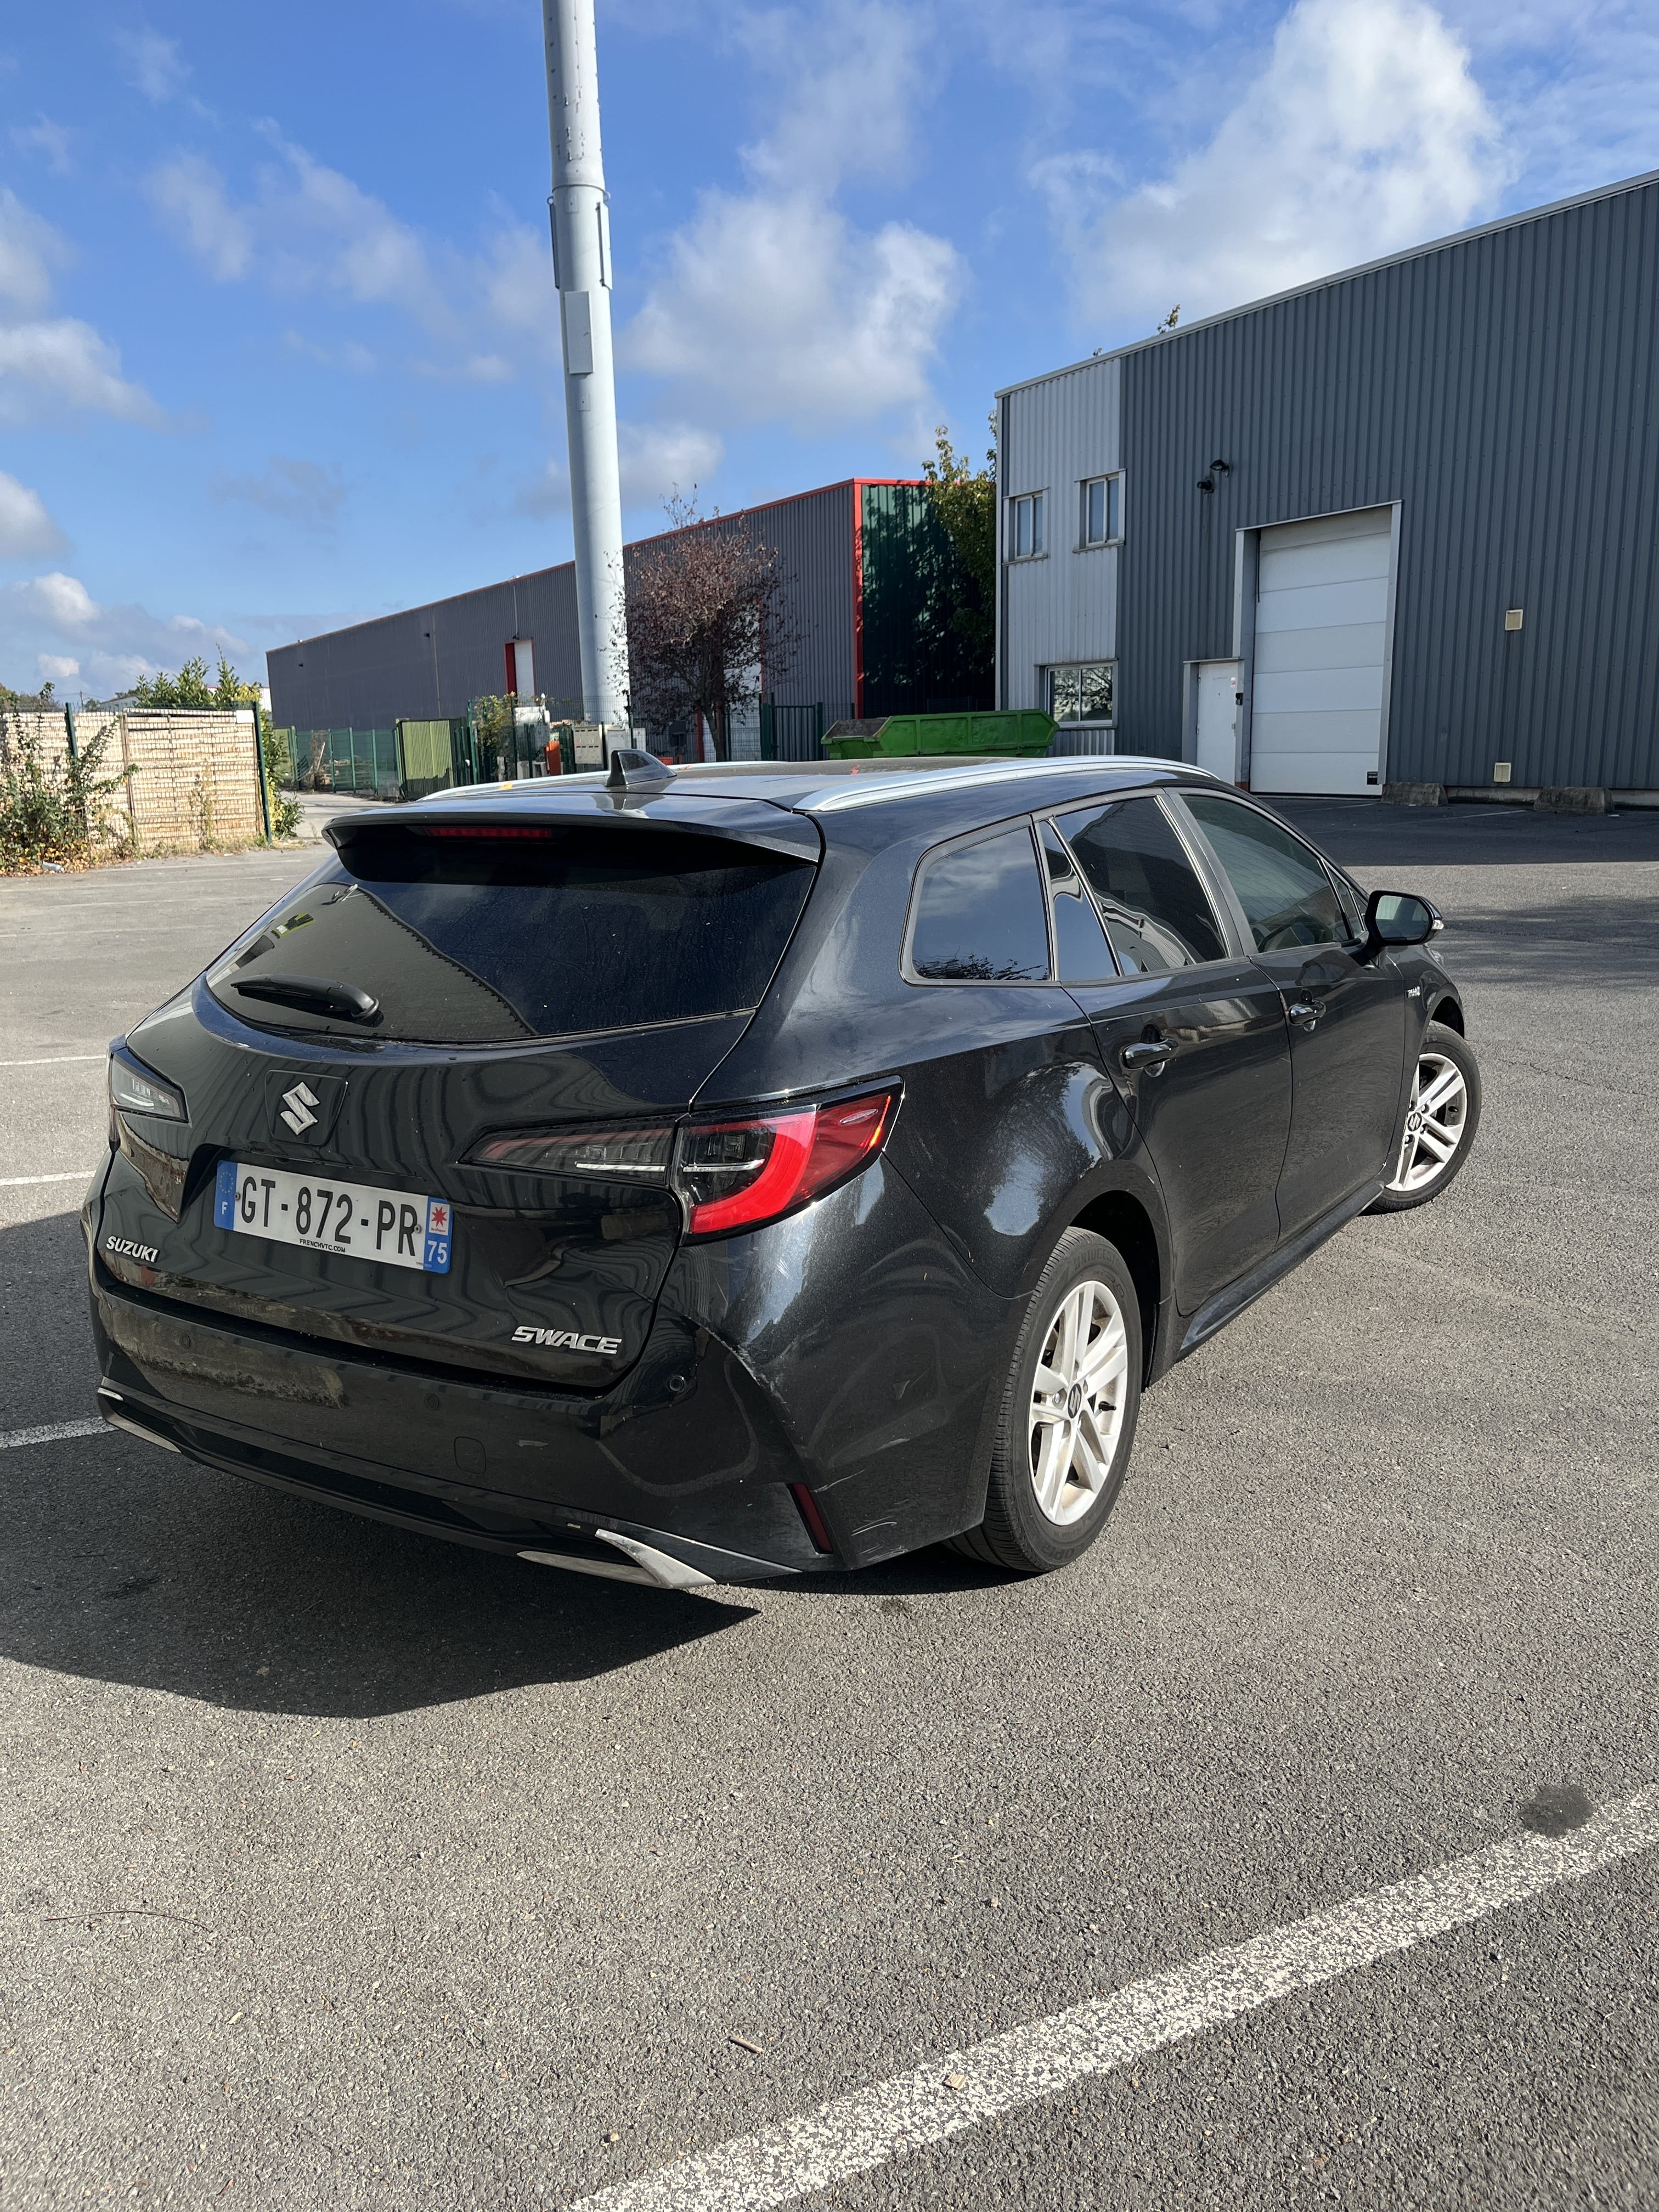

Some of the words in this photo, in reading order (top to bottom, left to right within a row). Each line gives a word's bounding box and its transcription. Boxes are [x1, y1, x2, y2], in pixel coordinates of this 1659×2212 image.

[221, 1201, 228, 1215] F
[241, 1176, 418, 1257] GT-872-PR
[106, 1235, 159, 1262] SUZUKI
[300, 1238, 346, 1253] FRENCHVTC.COM
[428, 1240, 448, 1264] 75
[511, 1325, 622, 1355] SWACE
